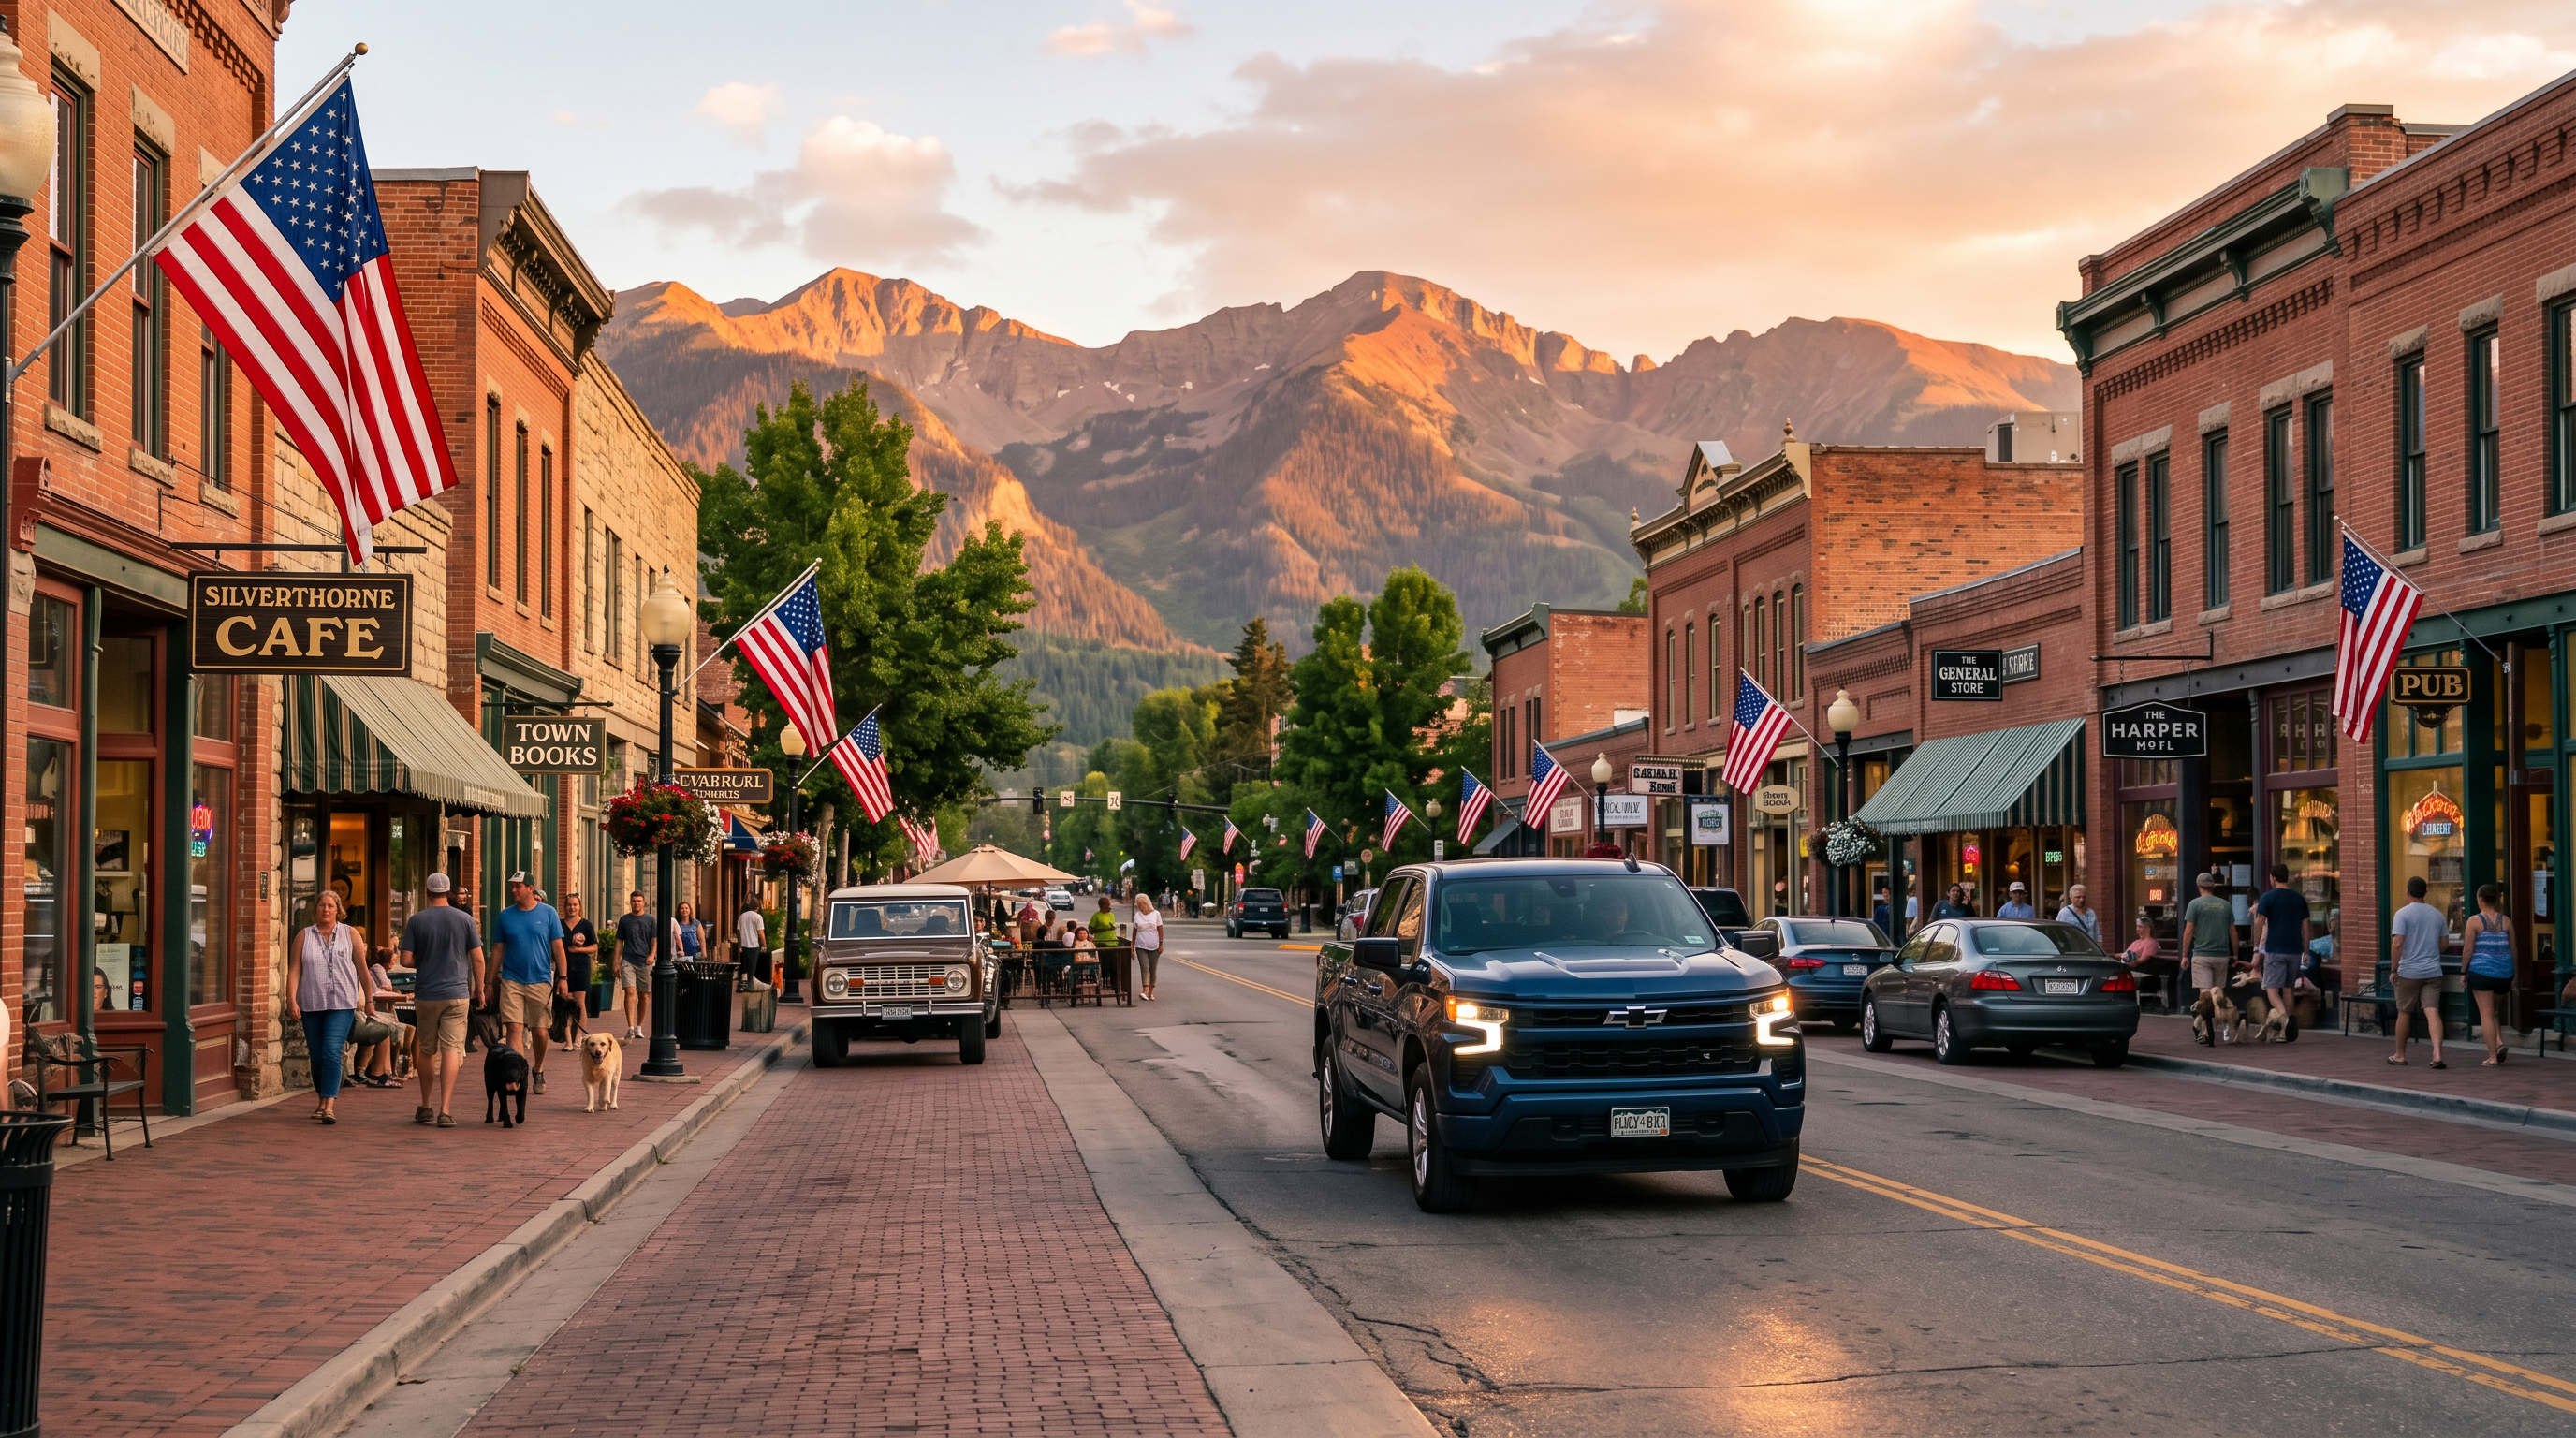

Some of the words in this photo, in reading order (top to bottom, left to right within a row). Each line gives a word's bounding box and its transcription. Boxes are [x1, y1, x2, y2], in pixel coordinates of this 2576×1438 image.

[205, 586, 396, 609] SILVERTHORNE
[215, 615, 385, 660] CAFE
[1961, 656, 1977, 665] THE
[1939, 667, 1997, 681] GENERAL
[1951, 682, 1983, 694] STORE
[2400, 674, 2464, 697] PUB
[2144, 711, 2166, 720] THE
[515, 723, 593, 742] TOWN
[2112, 723, 2199, 738] HARPER
[509, 745, 597, 766] BOOKS
